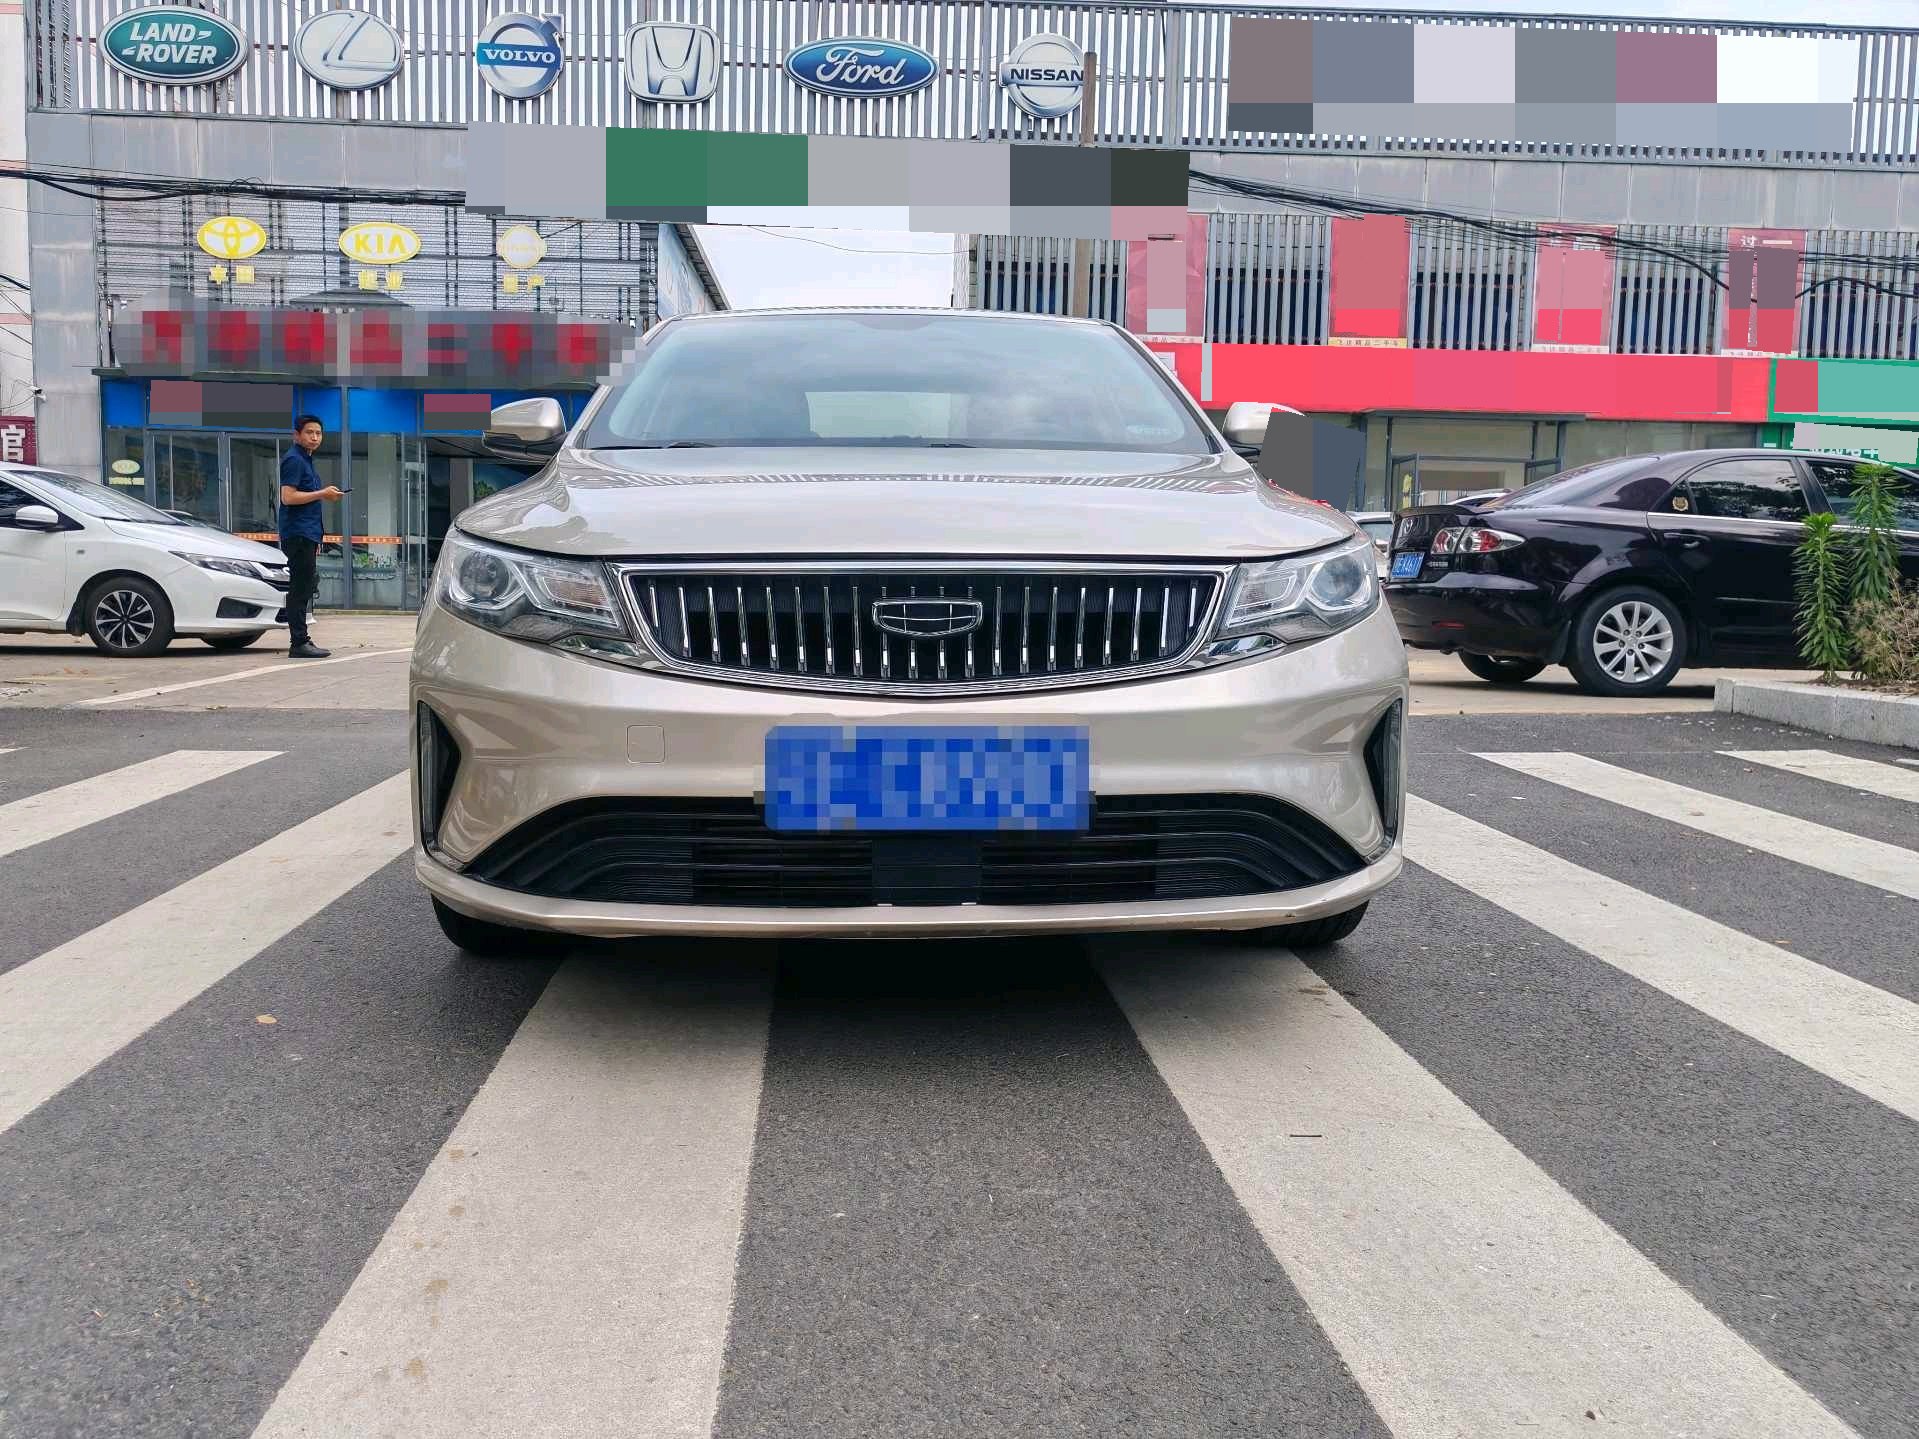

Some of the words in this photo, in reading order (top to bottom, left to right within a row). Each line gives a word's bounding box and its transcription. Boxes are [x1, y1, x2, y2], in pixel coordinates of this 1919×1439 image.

[130, 22, 196, 42] LAND
[136, 43, 217, 65] ROVER
[483, 48, 556, 64] VOLVO
[816, 46, 906, 84] Ford
[1010, 68, 1084, 82] NISSAN
[354, 232, 408, 254] KIA
